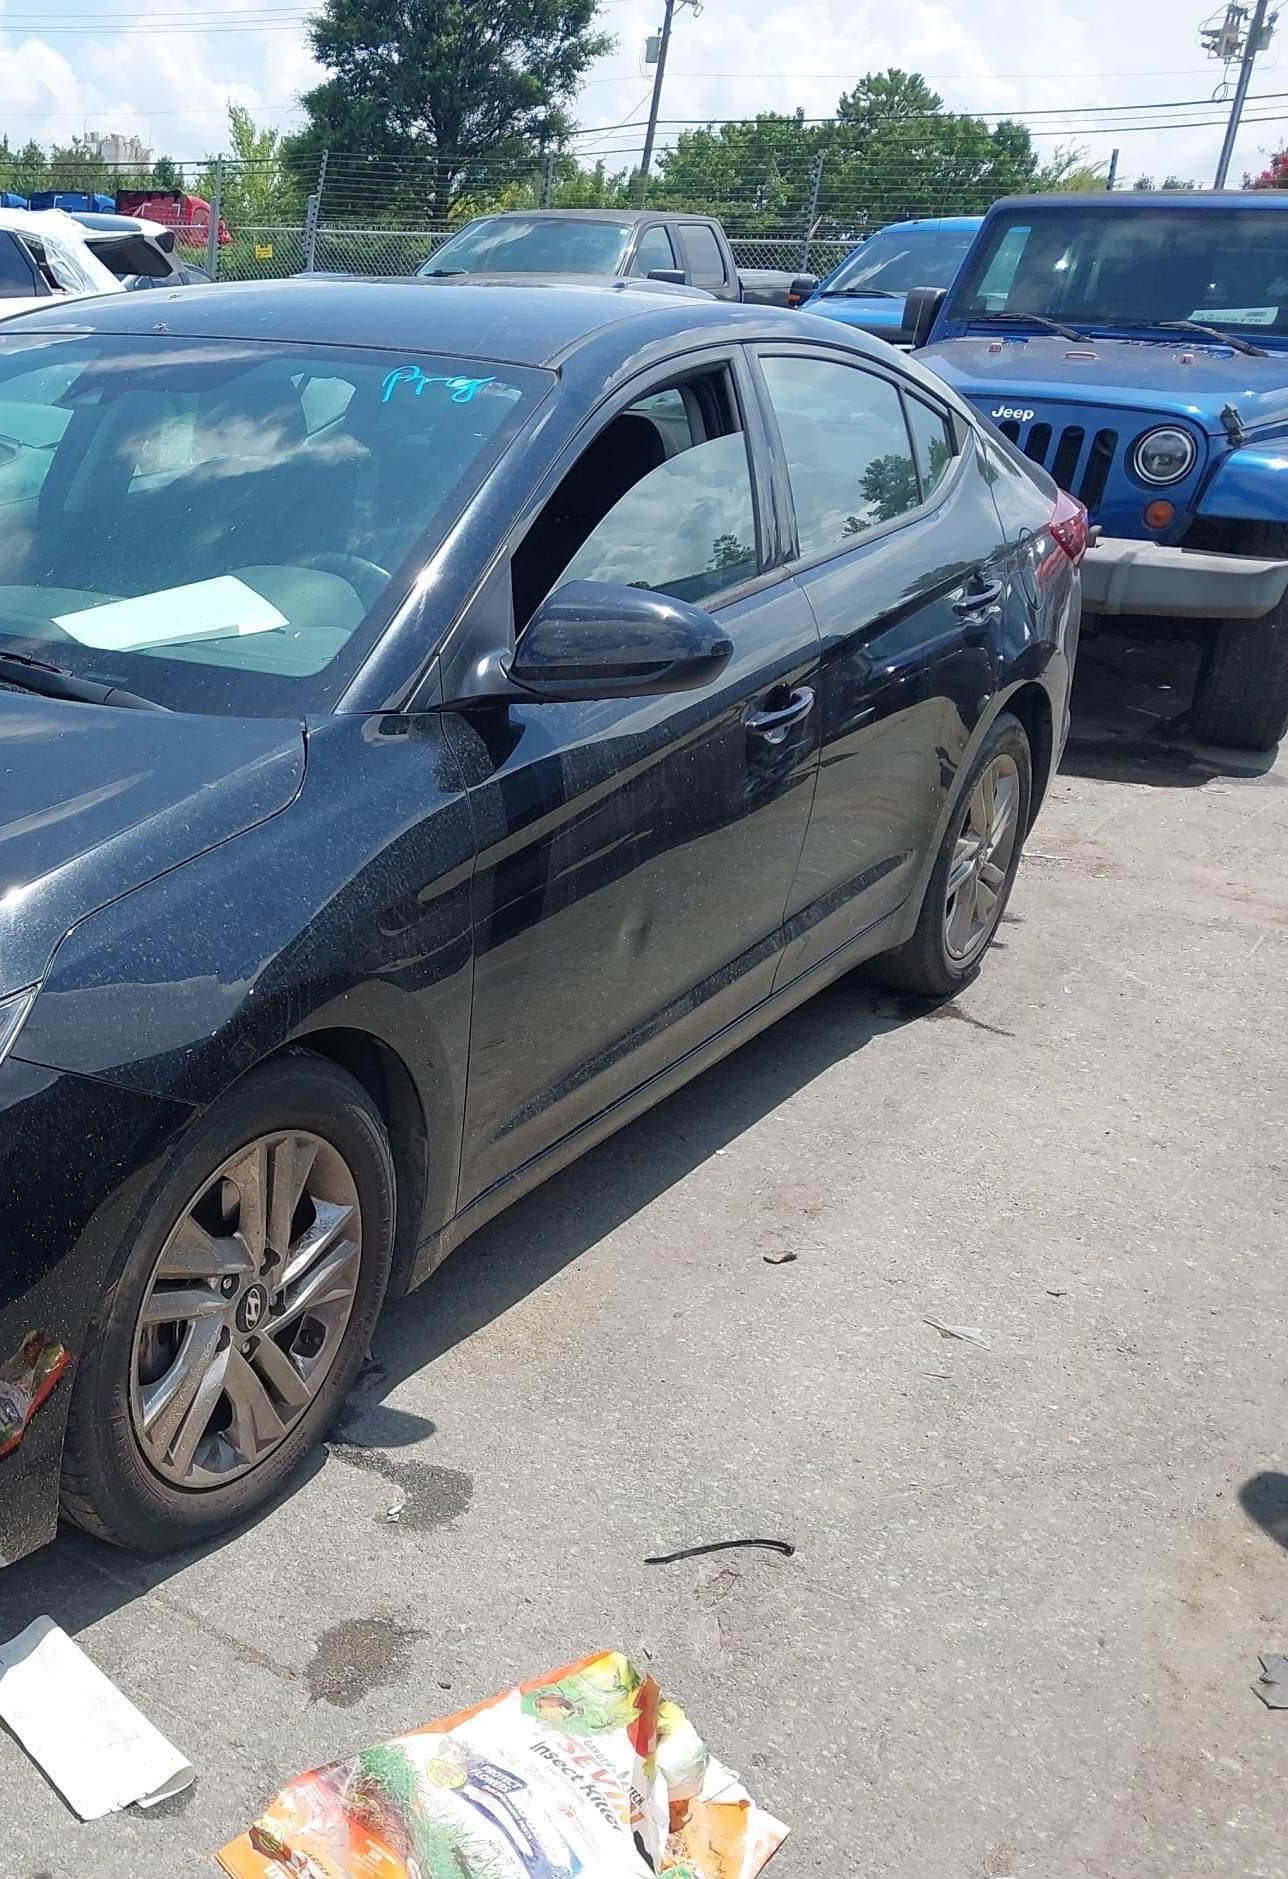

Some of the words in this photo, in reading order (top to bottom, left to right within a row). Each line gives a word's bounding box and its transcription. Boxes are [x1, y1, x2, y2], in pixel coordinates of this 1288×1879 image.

[992, 404, 1035, 422] Jeep
[470, 1768, 513, 1793] FLOWERS
[482, 1764, 524, 1789] PROTECT
[529, 1740, 585, 1783] Insect
[579, 1783, 626, 1835] Killer
